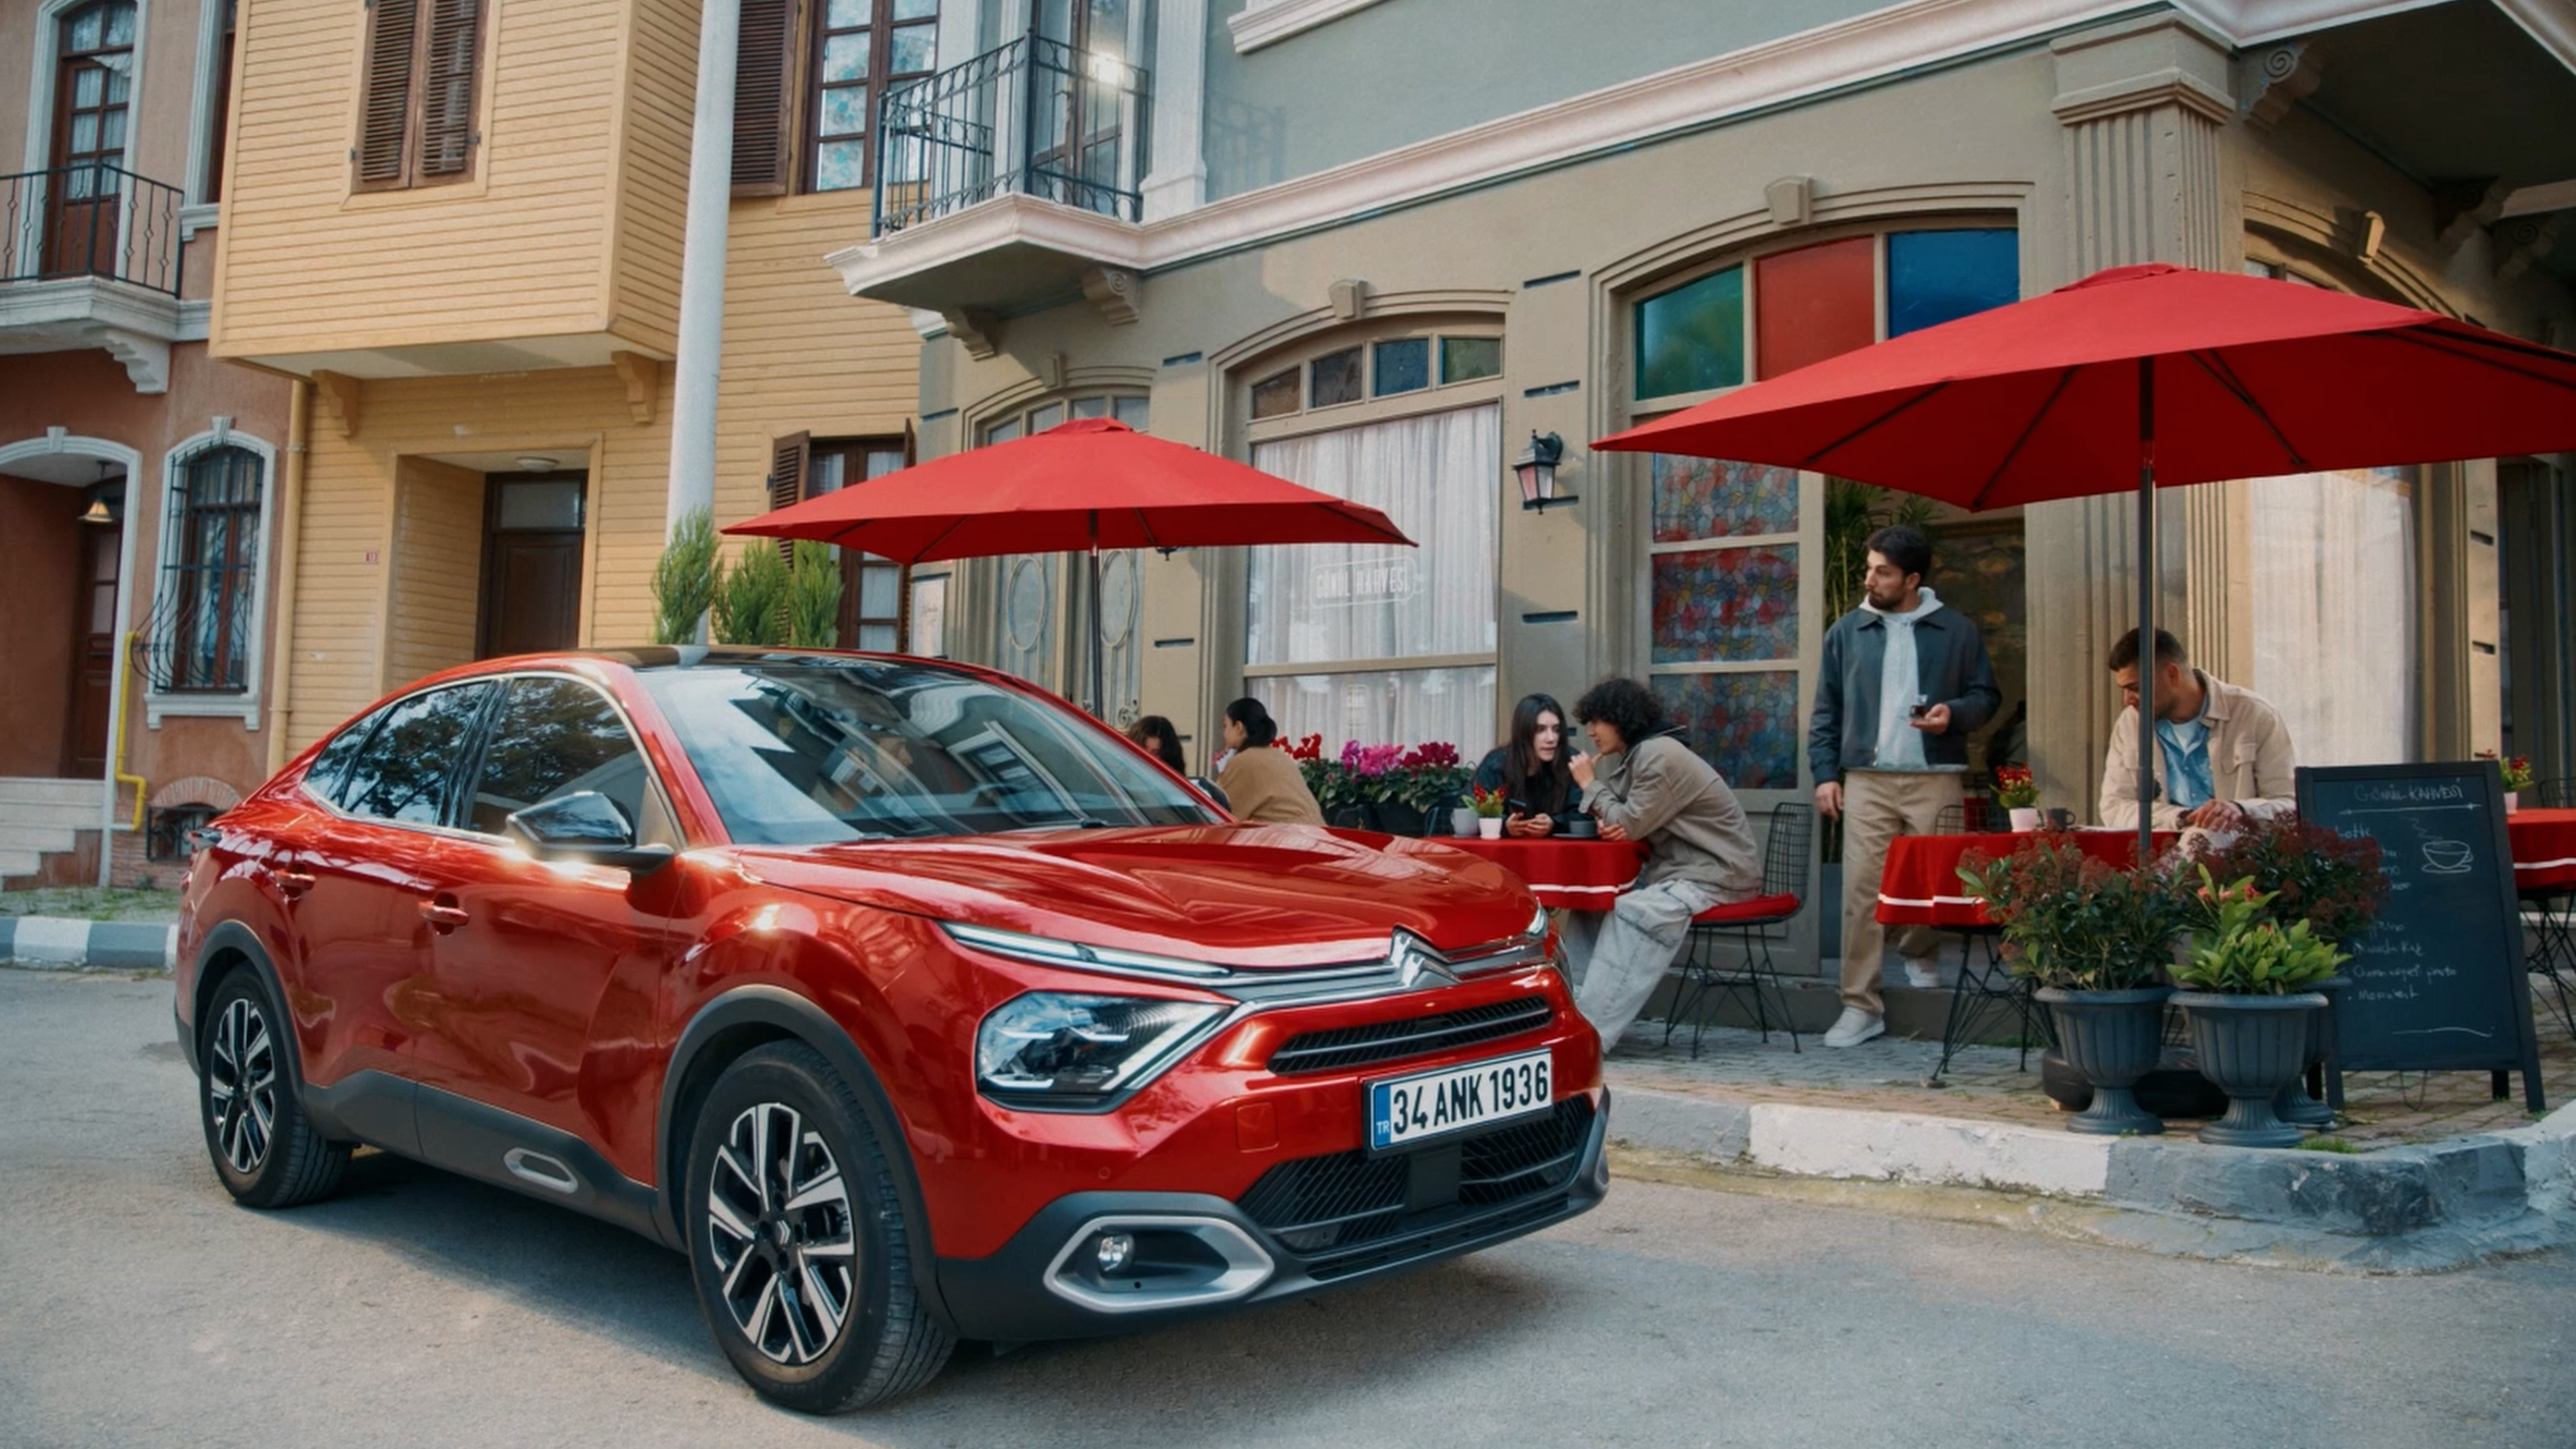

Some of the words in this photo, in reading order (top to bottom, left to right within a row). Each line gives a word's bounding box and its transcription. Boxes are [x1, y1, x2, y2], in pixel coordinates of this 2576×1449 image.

[1376, 1120, 1390, 1135] TR
[1393, 1085, 1428, 1135] 34
[1434, 1073, 1483, 1126] ANK
[1489, 1061, 1548, 1112] 1936
